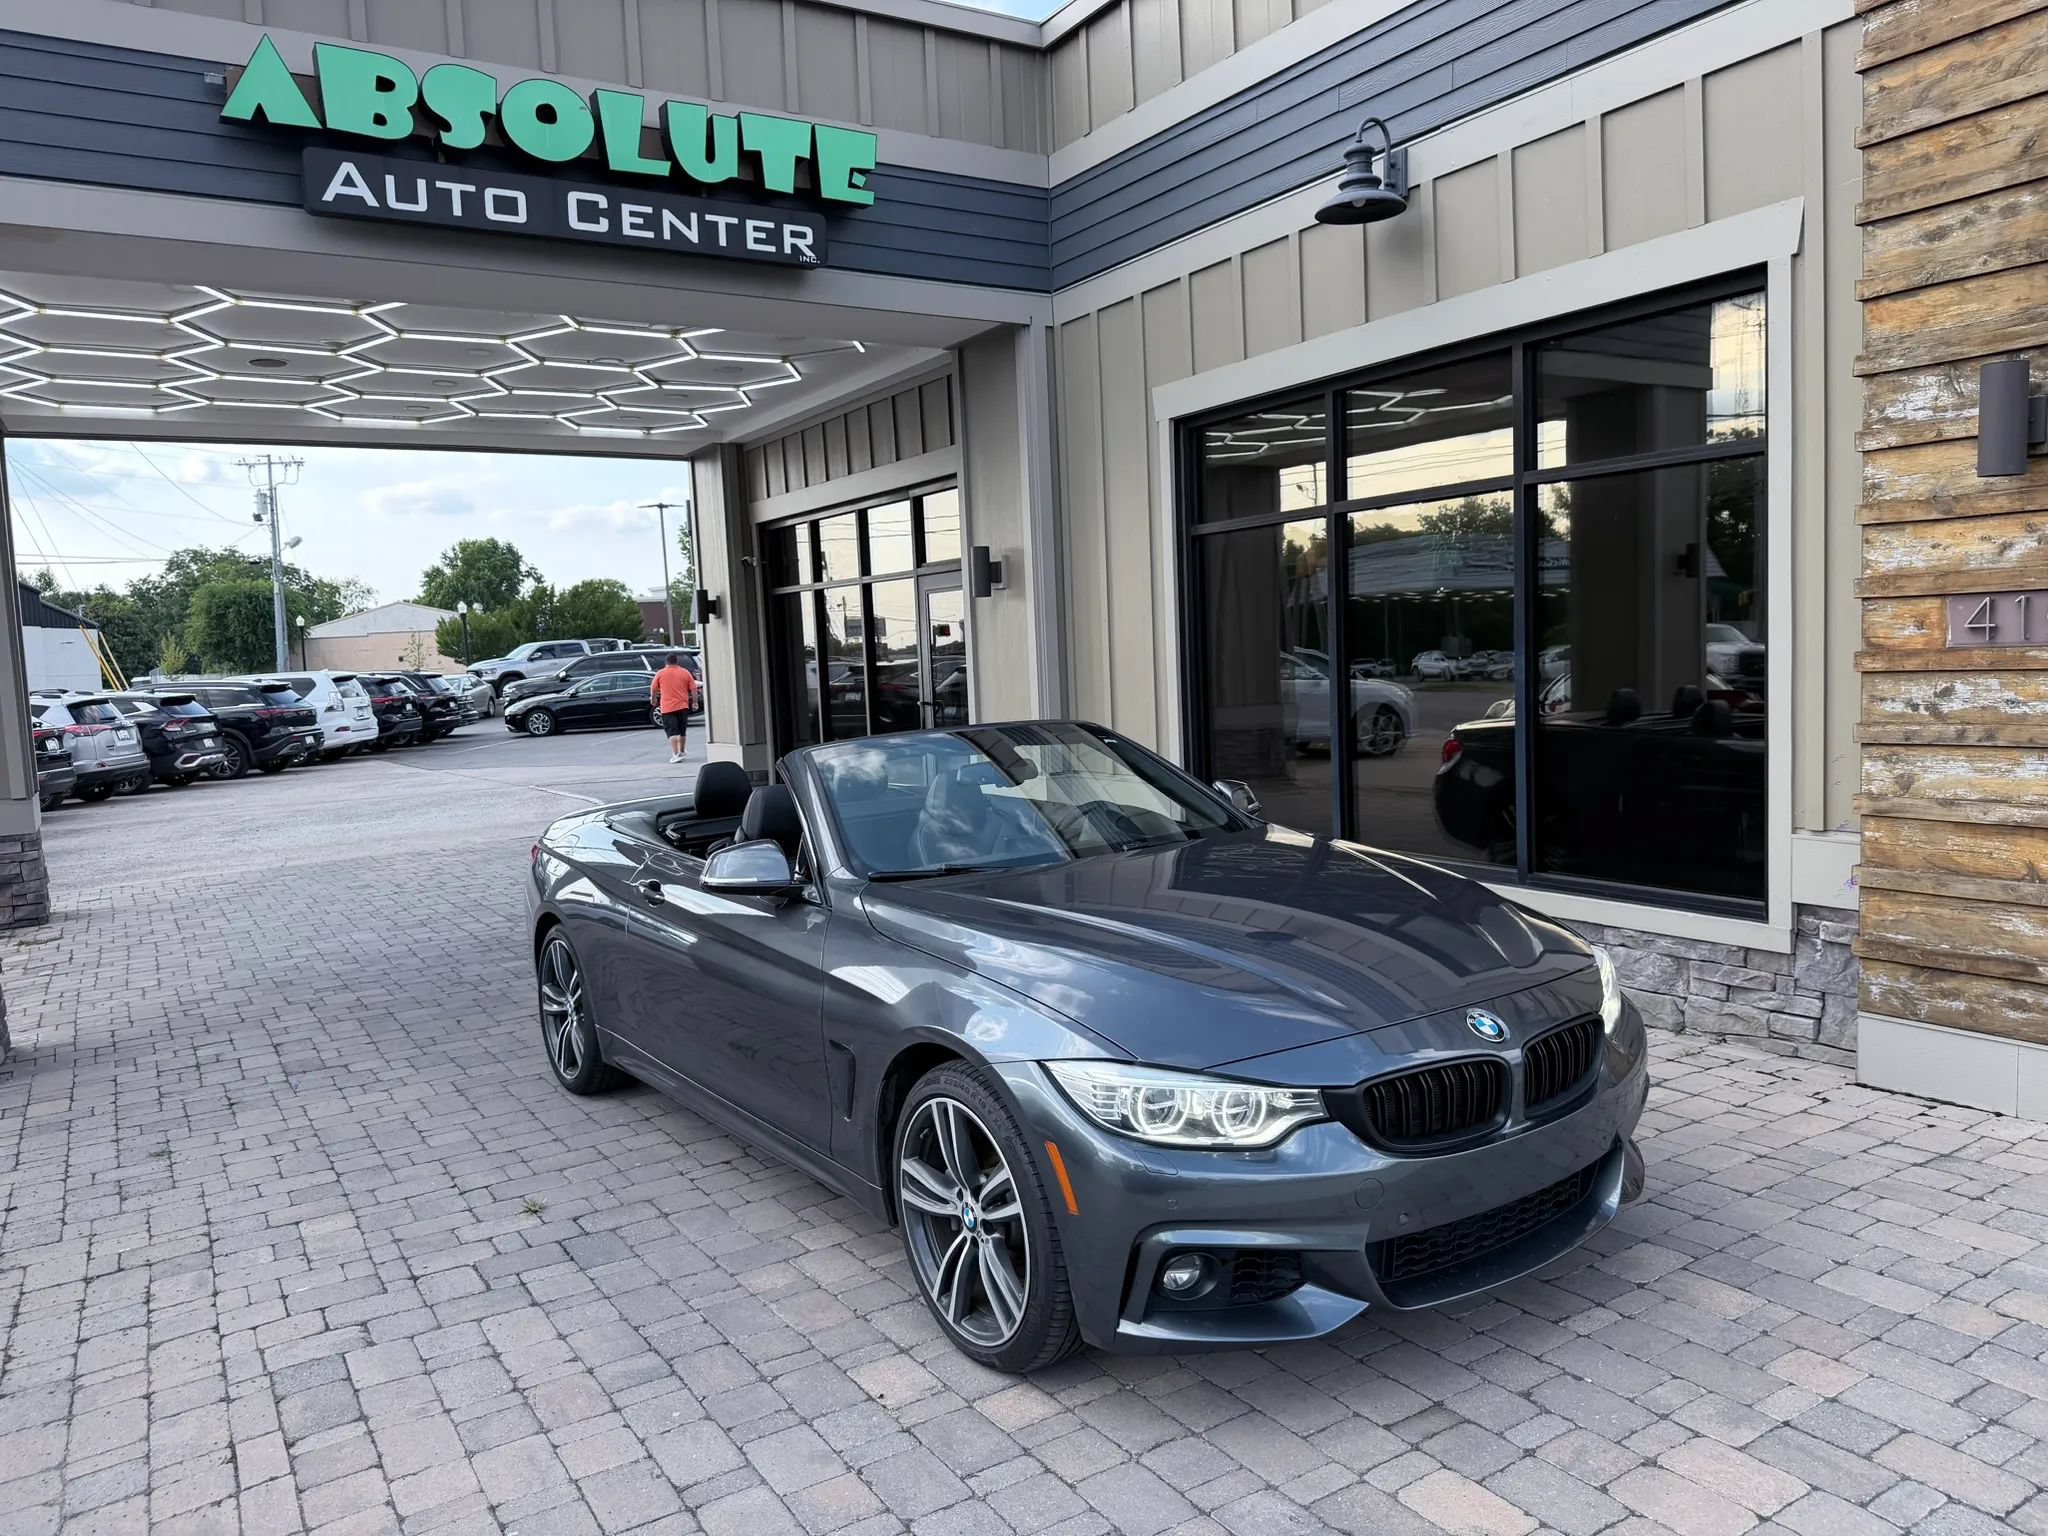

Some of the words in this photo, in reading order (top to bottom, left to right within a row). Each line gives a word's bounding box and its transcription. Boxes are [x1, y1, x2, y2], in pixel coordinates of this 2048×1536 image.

[220, 33, 877, 206] ABSOLUTE
[321, 161, 527, 224] AUTO
[567, 190, 816, 256] CENTER
[799, 255, 820, 264] INC.
[1964, 595, 2048, 641] 41
